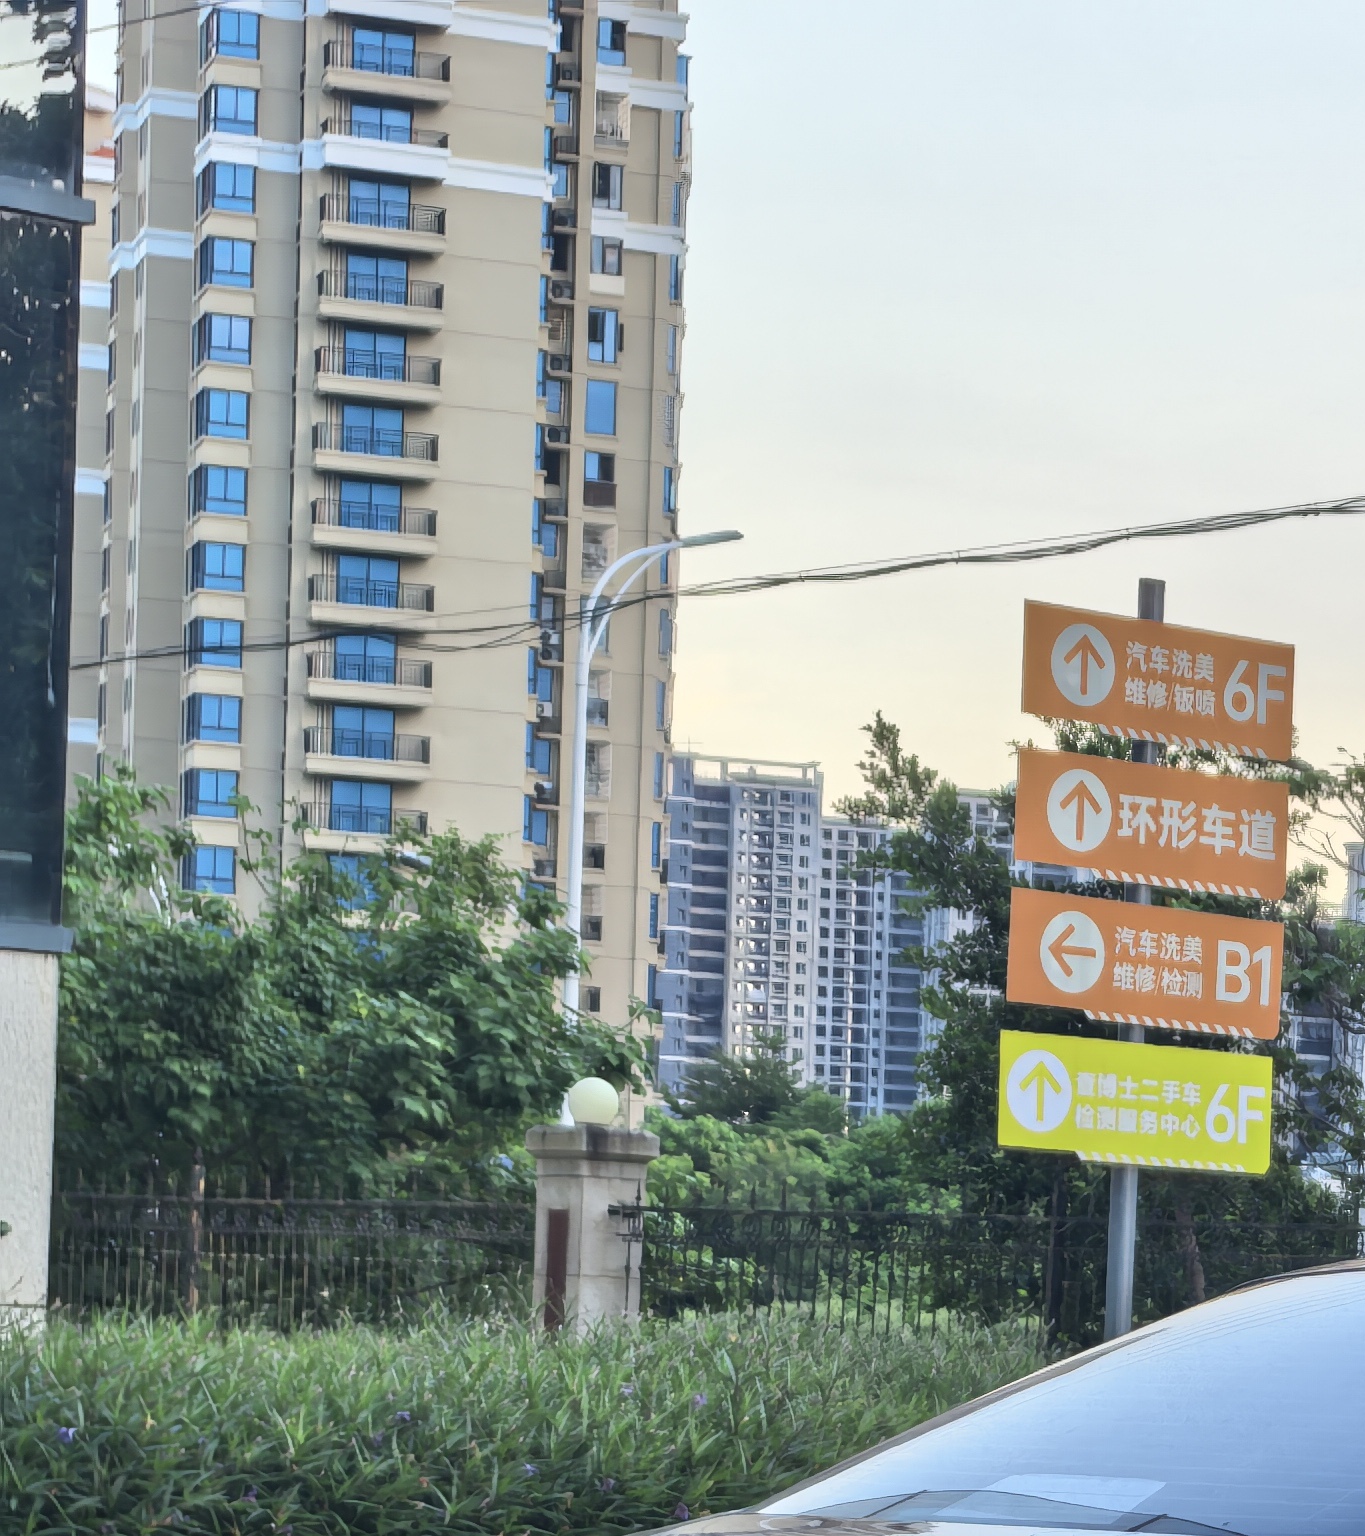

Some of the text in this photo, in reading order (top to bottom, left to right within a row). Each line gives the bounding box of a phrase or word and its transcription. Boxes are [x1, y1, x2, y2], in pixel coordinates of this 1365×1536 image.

[1126, 640, 1215, 683] 汽车洗美
[1223, 659, 1287, 725] 6F
[1117, 793, 1277, 861] 环形车道
[1114, 925, 1203, 966] 汽车洗美
[1215, 939, 1272, 1007] B1
[1205, 1083, 1266, 1144] 6F
